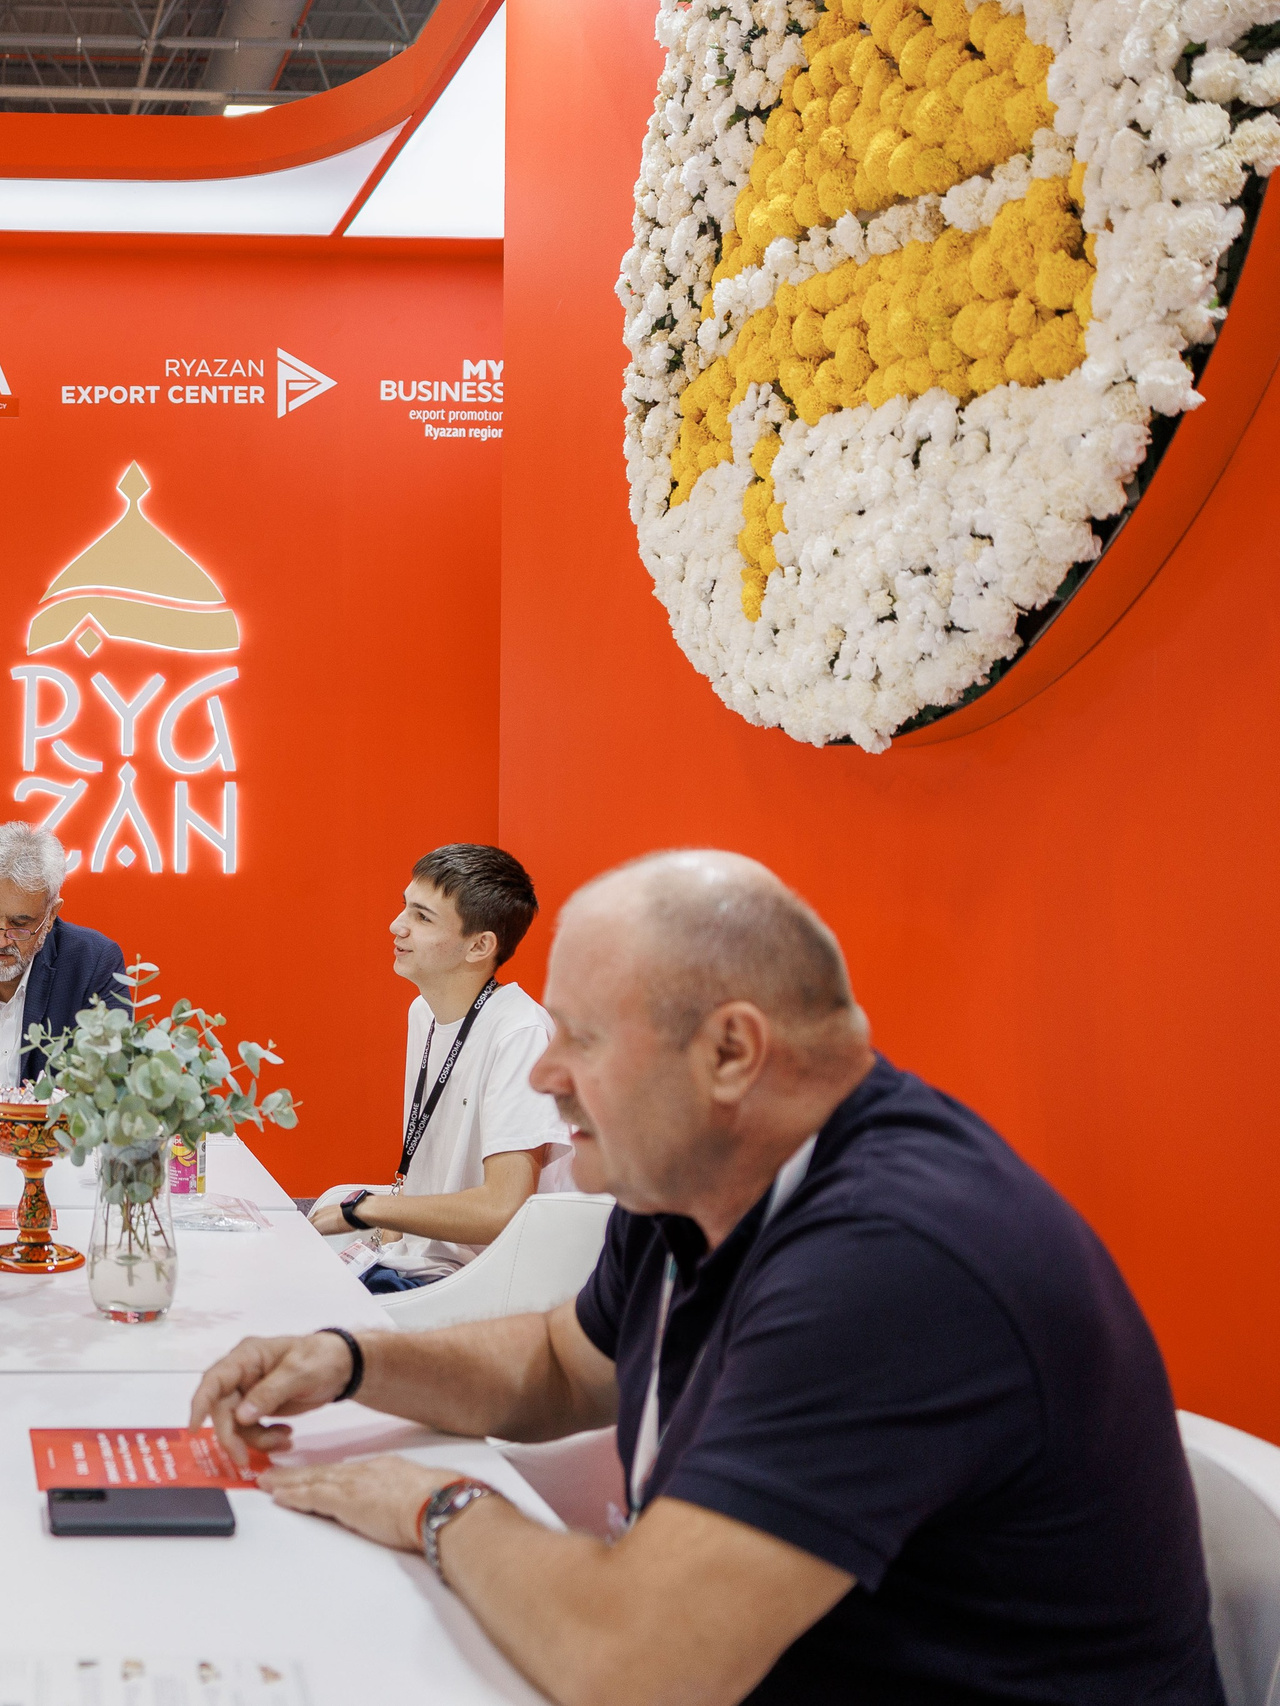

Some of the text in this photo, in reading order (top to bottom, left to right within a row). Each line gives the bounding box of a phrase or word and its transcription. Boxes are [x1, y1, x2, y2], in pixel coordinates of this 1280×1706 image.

[165, 358, 264, 378] RYAZAN
[462, 359, 504, 380] MY
[61, 385, 265, 404] EXPORT CENTER
[379, 380, 504, 403] BUSINESS
[409, 408, 446, 423] export
[424, 424, 466, 440] Ryazan
[438, 1040, 463, 1084] COSMOHOME
[406, 1112, 430, 1156] COSMOHOME
